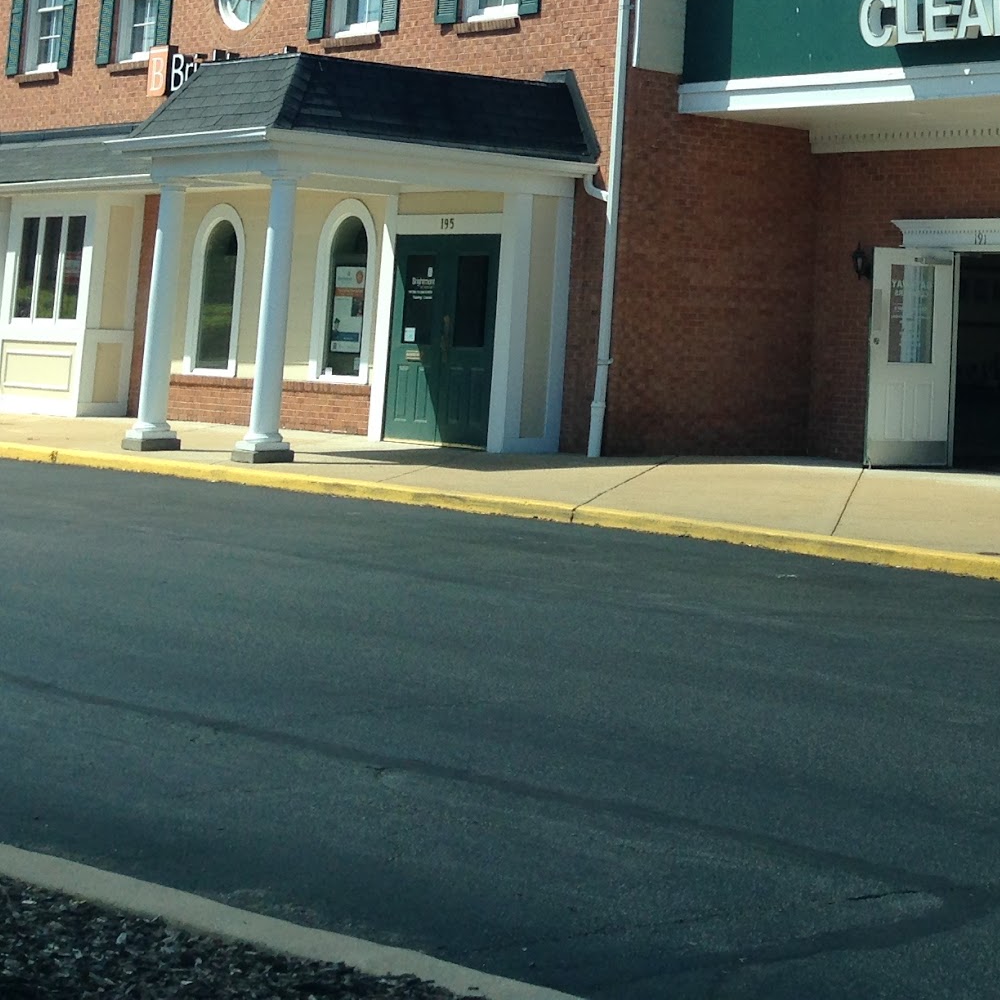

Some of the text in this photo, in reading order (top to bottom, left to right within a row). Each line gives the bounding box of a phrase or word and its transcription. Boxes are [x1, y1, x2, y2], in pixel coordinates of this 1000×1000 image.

[150, 57, 164, 92] B
[440, 217, 455, 230] 195
[974, 231, 987, 245] 191
